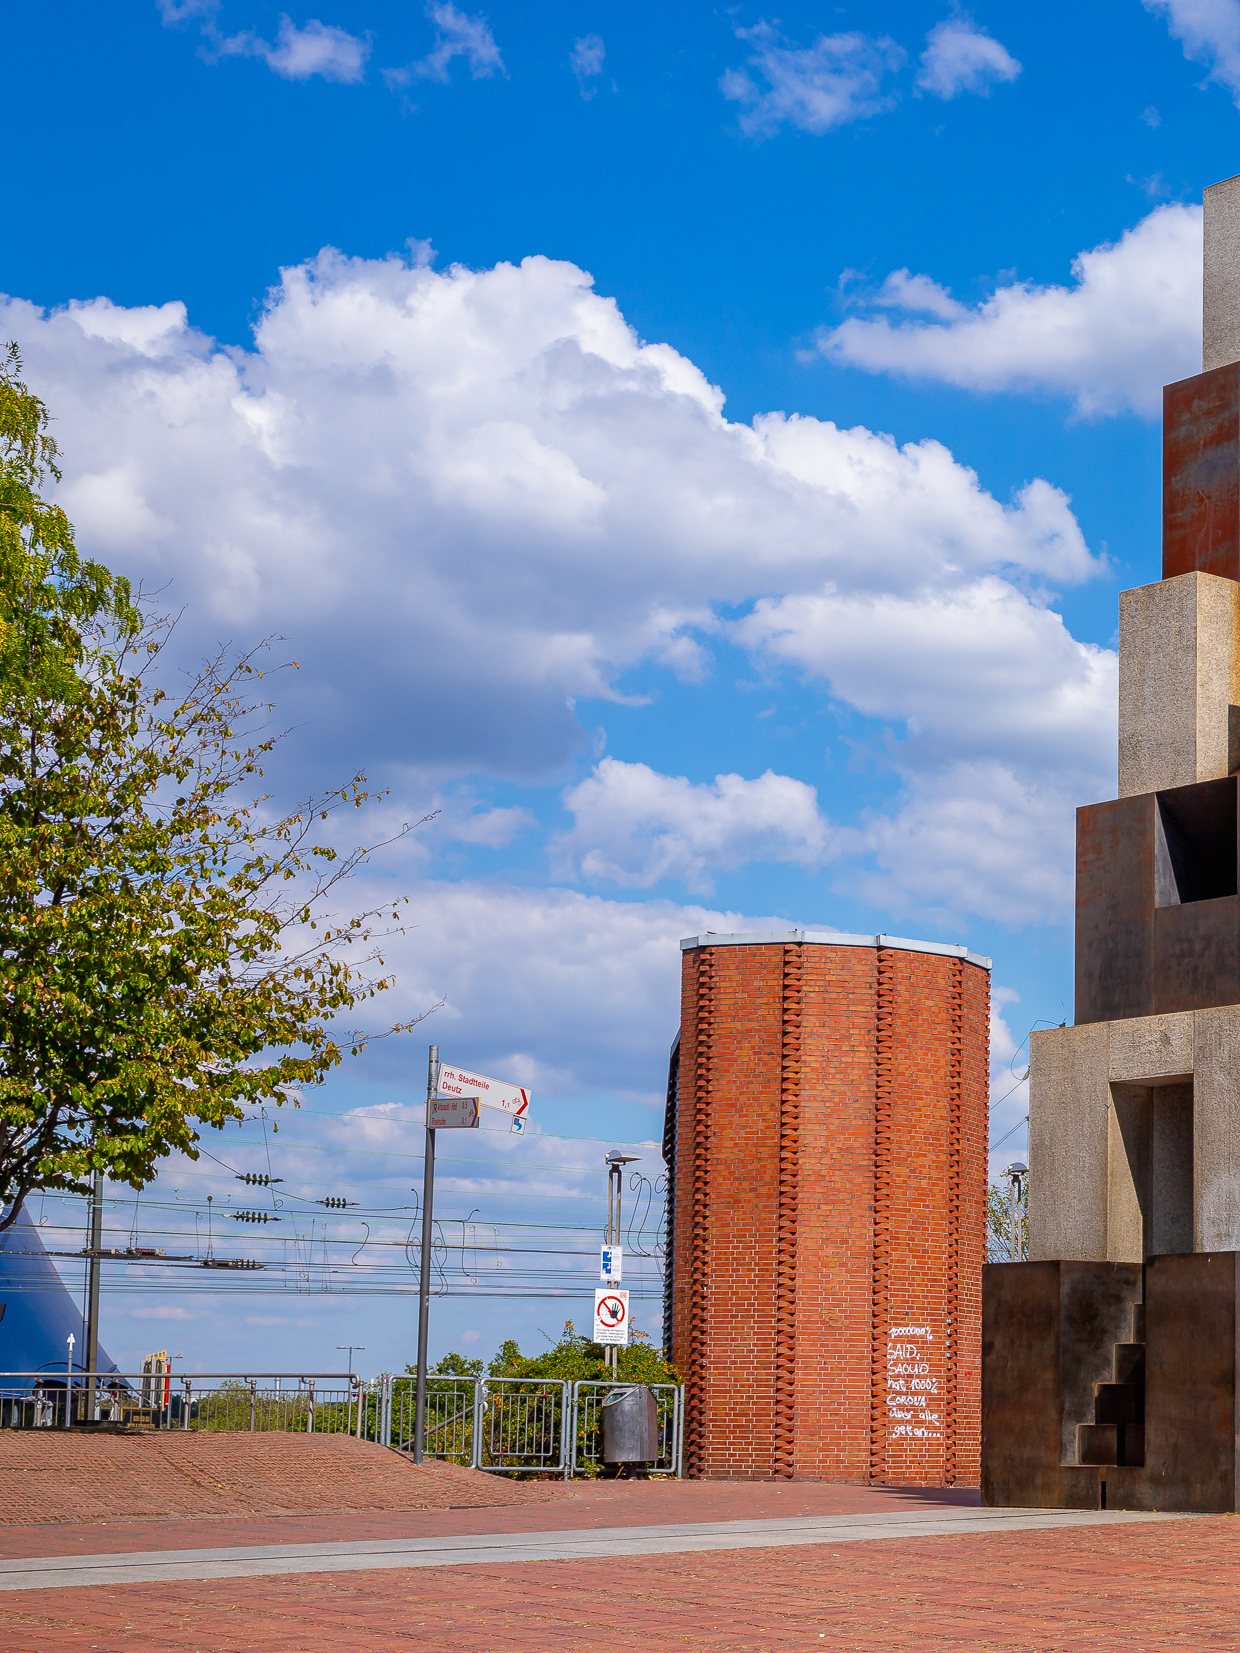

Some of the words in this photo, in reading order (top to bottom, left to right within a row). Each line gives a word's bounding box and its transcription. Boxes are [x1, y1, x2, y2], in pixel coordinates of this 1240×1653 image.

[443, 1071, 456, 1080] rrh.
[457, 1073, 490, 1091] Stadtteile
[441, 1081, 463, 1095] Deutz
[501, 1099, 510, 1109] 1,1
[887, 1376, 906, 1392] hat
[918, 1409, 940, 1426] alle
